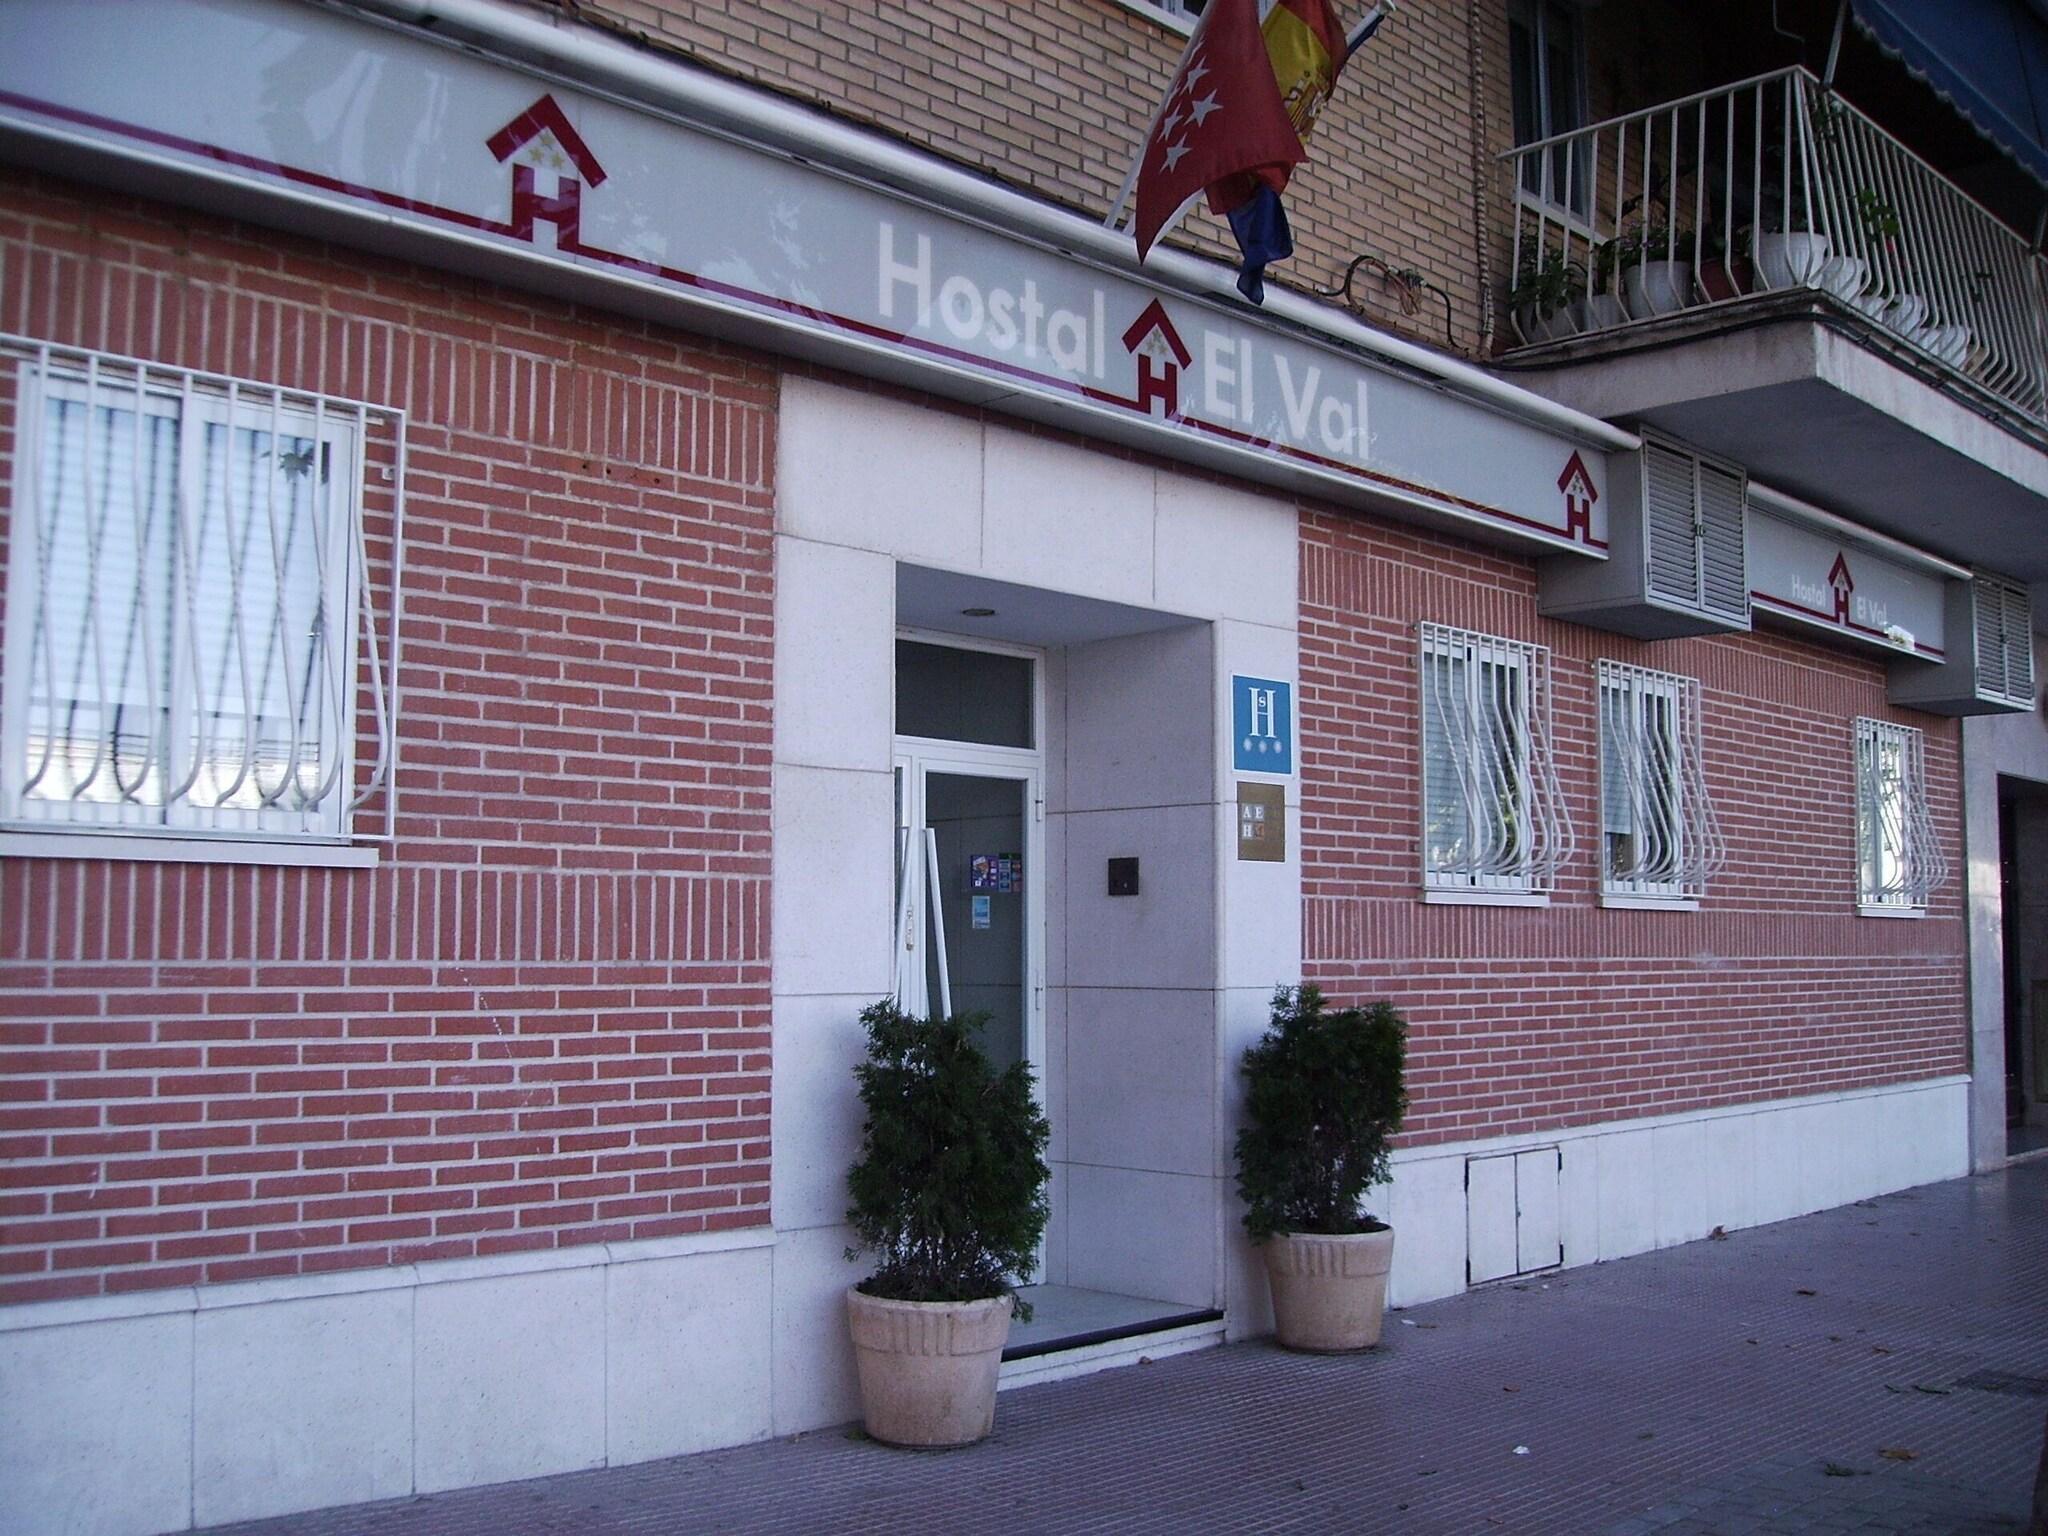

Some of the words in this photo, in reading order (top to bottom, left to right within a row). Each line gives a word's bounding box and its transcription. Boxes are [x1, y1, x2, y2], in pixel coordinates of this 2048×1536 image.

[878, 221, 1106, 379] Hostal
[1203, 329, 1254, 425] El
[1274, 354, 1370, 460] Val
[1791, 574, 1826, 607] Hostal
[1248, 687, 1277, 738] H
